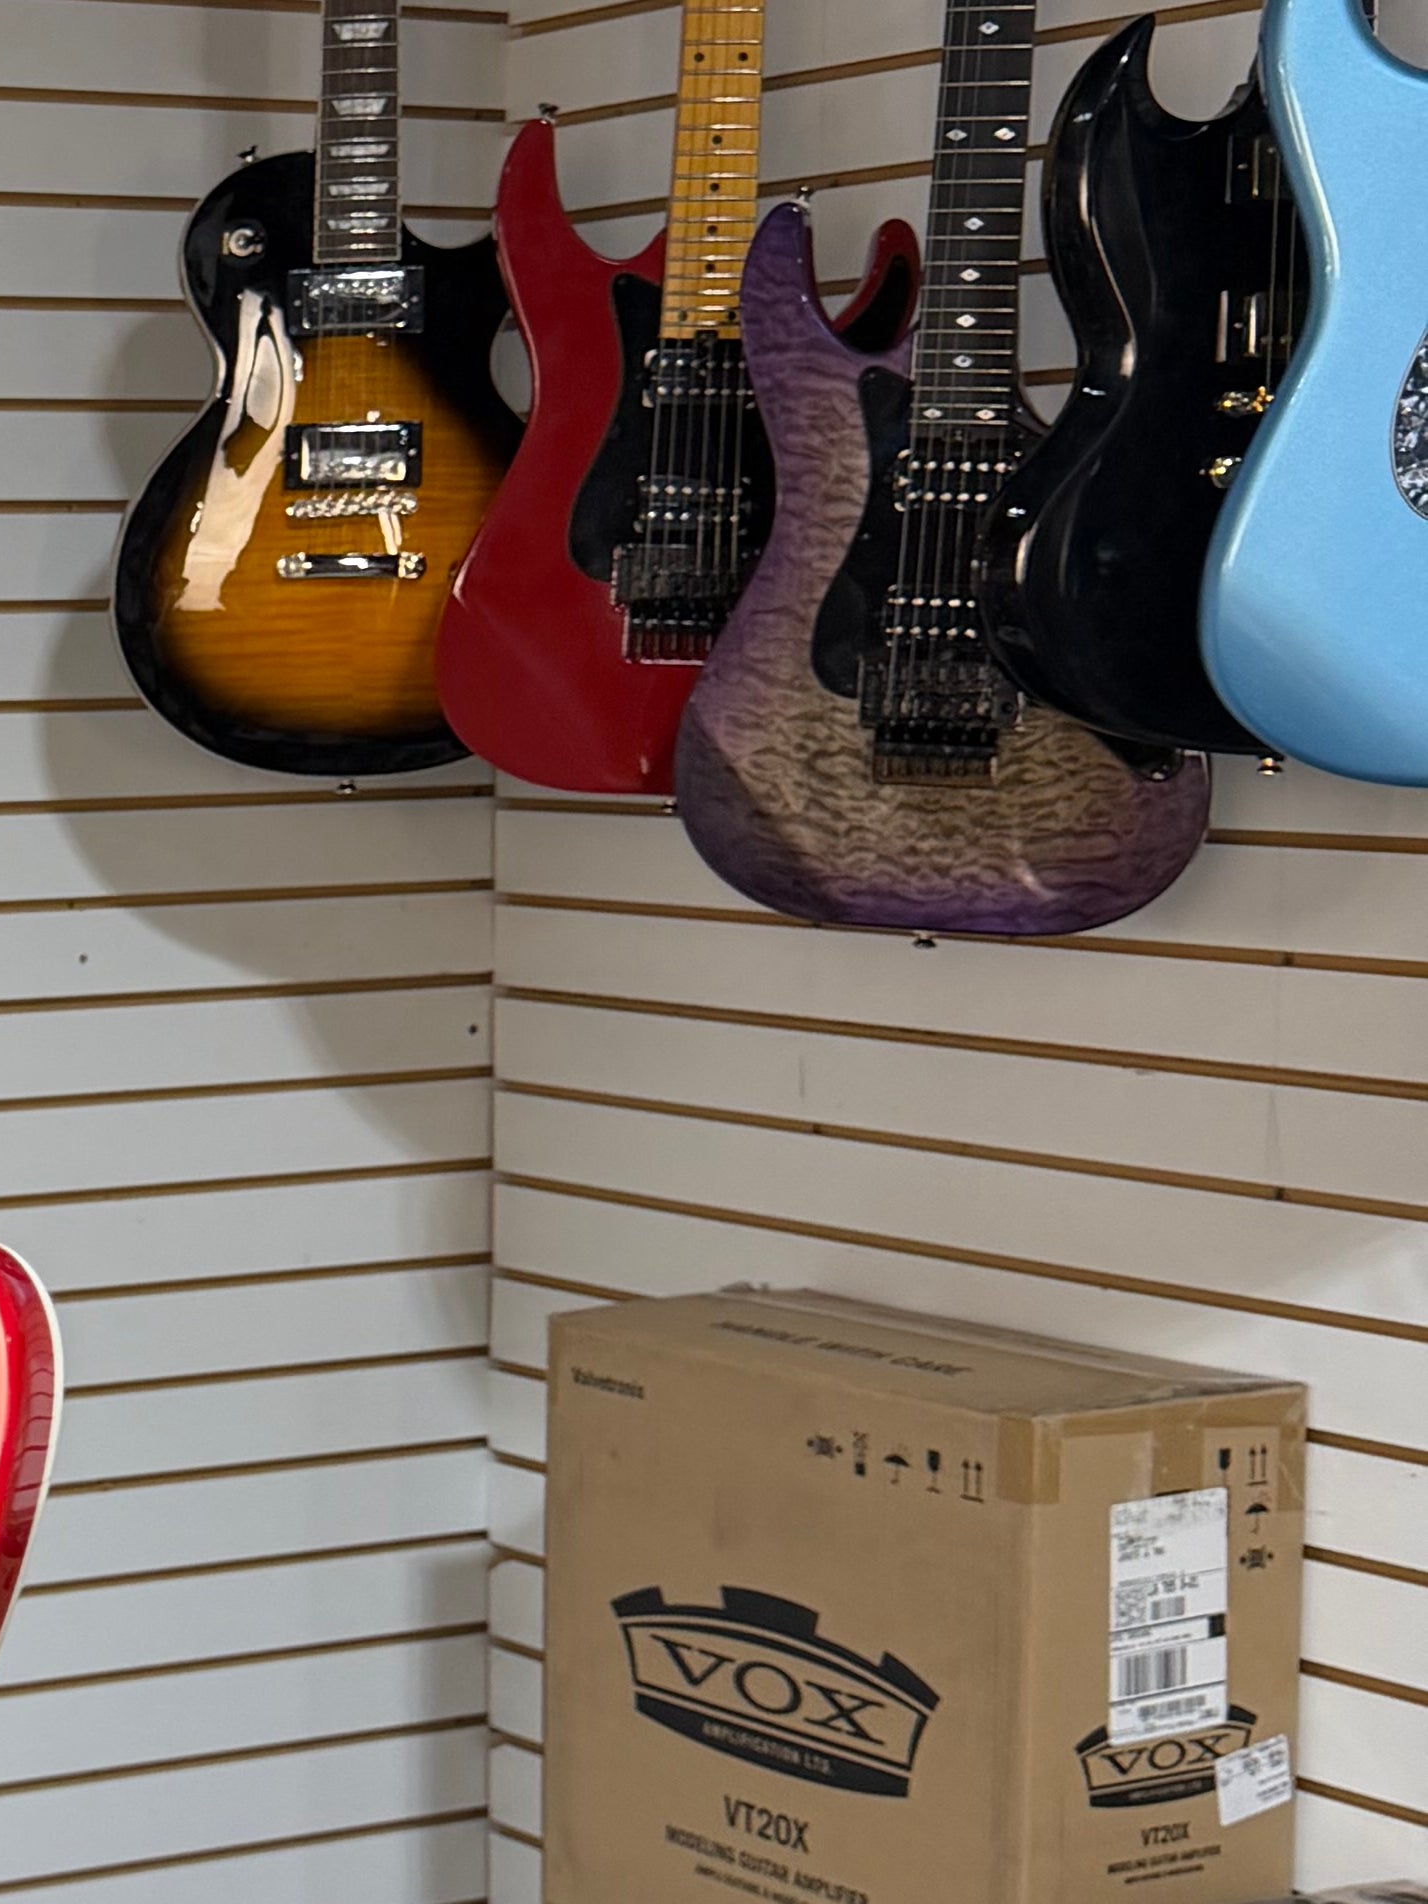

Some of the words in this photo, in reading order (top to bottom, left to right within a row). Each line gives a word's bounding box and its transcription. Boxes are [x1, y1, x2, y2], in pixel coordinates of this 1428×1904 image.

[649, 1634, 886, 1746] VOX
[1102, 1733, 1231, 1776] VOX
[724, 1794, 810, 1854] VT20X
